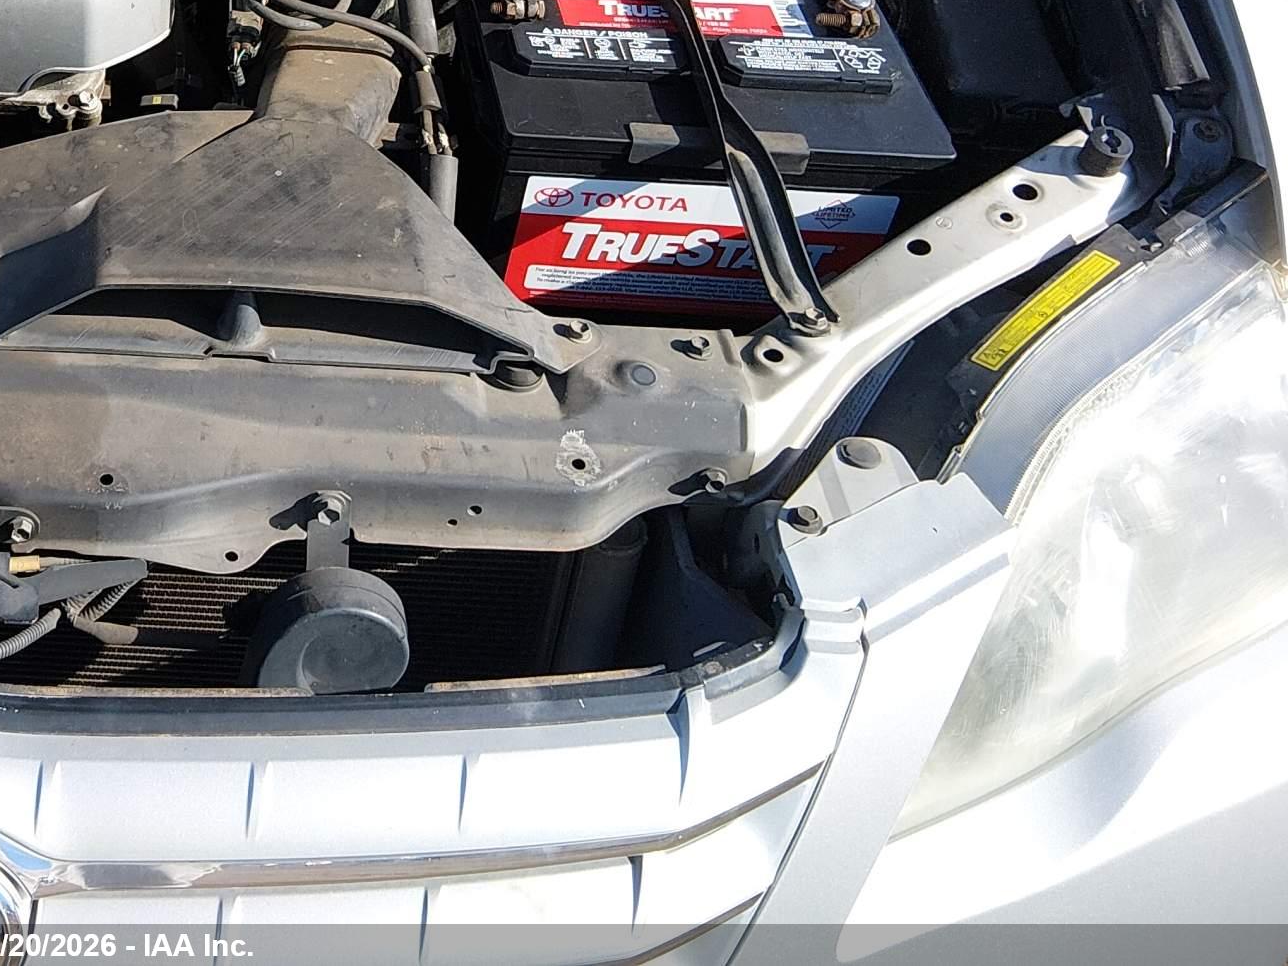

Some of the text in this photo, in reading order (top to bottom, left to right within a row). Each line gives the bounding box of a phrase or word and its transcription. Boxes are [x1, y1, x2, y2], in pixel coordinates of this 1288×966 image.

[553, 28, 598, 37] DANGER
[608, 30, 648, 38] POISON
[580, 192, 688, 212] TOYOTA
